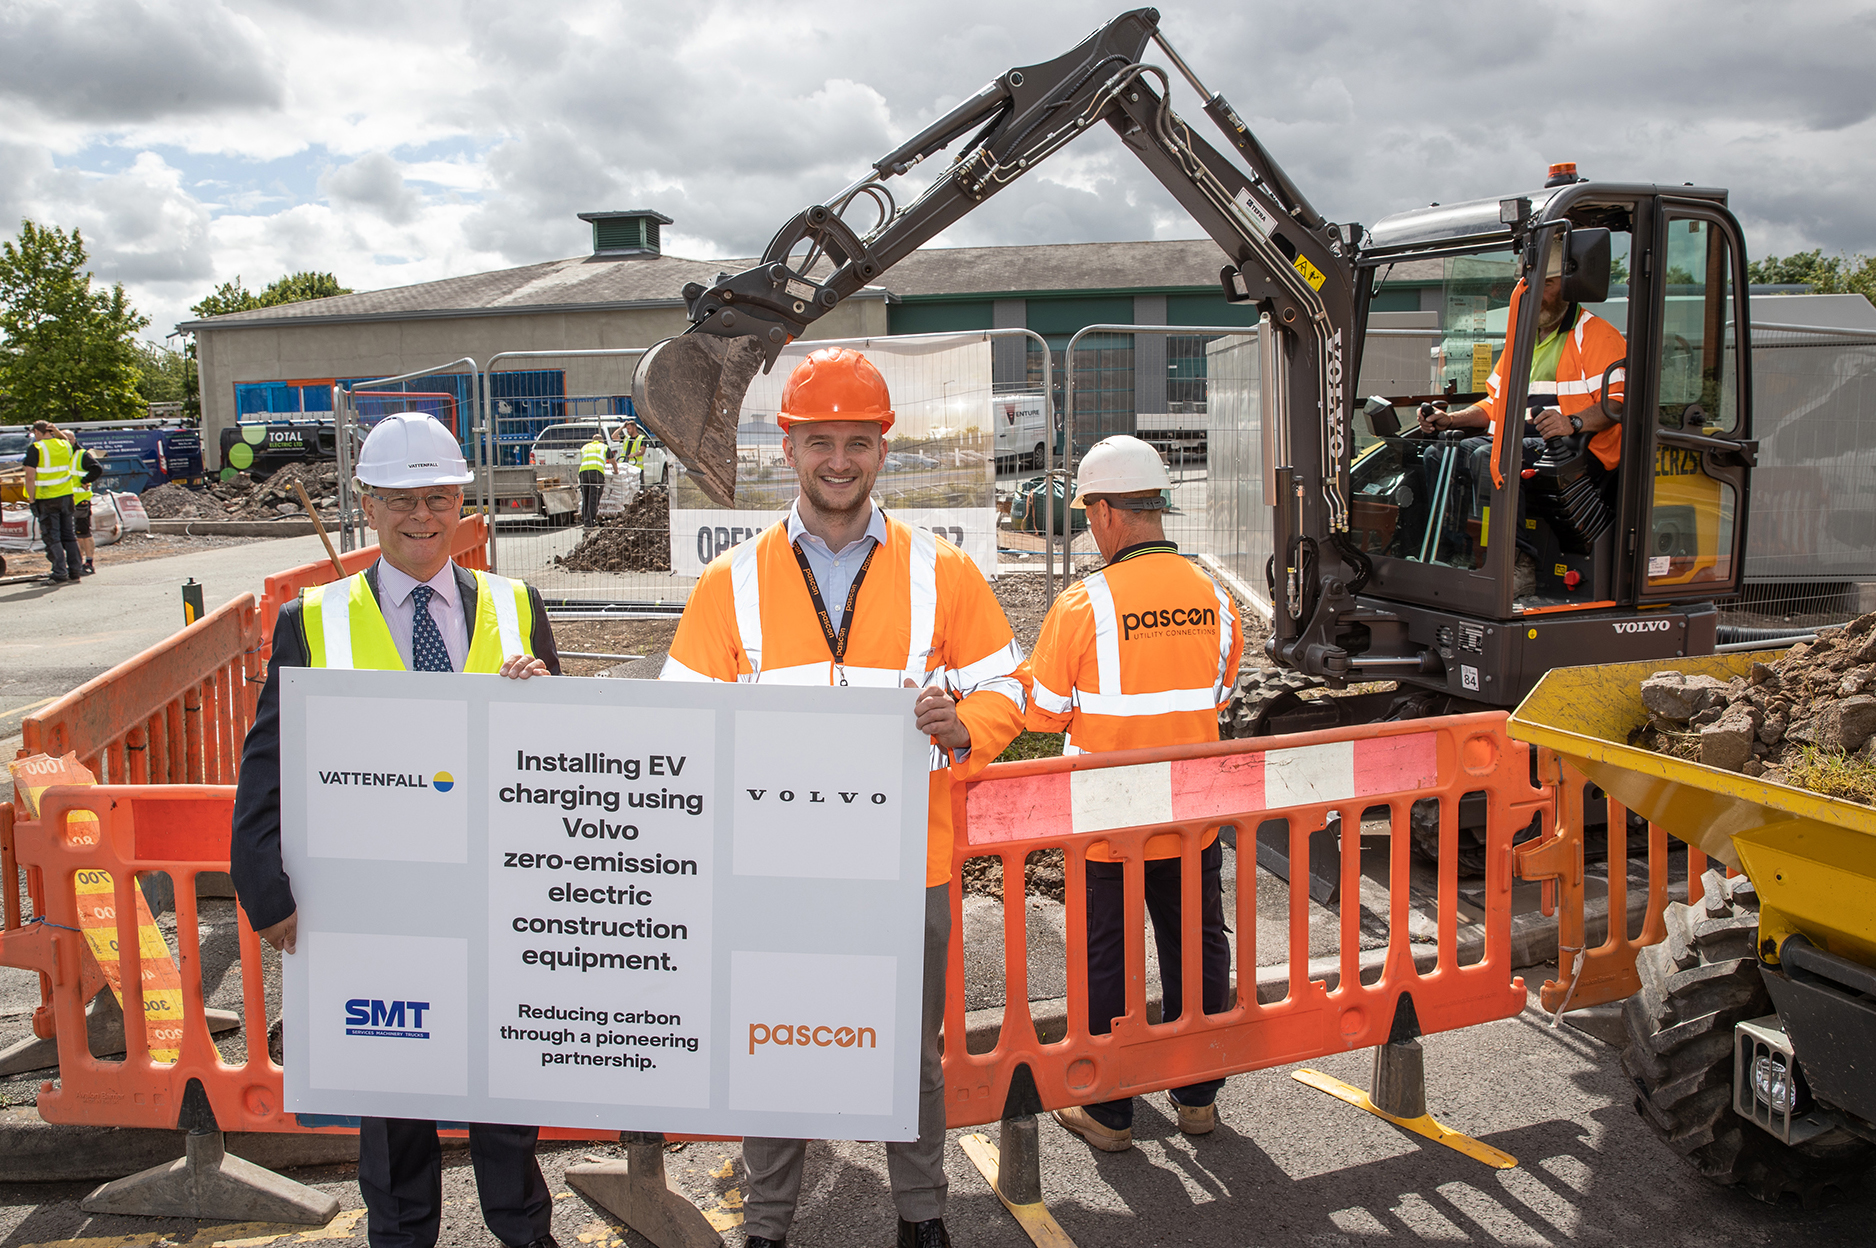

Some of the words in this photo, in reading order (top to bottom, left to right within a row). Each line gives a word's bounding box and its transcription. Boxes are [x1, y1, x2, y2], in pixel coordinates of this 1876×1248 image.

[1327, 328, 1344, 458] VOLVO
[269, 432, 303, 442] TOTAL
[803, 568, 819, 596] pascon
[846, 584, 858, 612] pascon
[818, 610, 835, 639] pascon
[1122, 608, 1215, 641] pascon
[1133, 631, 1163, 640] UTILITY
[1165, 628, 1216, 637] CONNECTIONS
[1612, 620, 1671, 634] VOLVO
[836, 627, 847, 657] pascon
[1464, 674, 1477, 687] 84
[517, 750, 641, 780] Installing
[649, 755, 686, 776] EV
[318, 770, 428, 788] VATTENFALL
[499, 782, 620, 812] charging
[627, 787, 704, 816] using
[746, 789, 887, 805] VOLVO
[562, 817, 639, 840] Volvo
[503, 851, 698, 875] zero-emission
[548, 882, 652, 906] electric
[512, 917, 688, 940] construction
[522, 946, 678, 973] equipment.
[345, 998, 430, 1029] SMT
[518, 1003, 609, 1026] Reducing
[613, 1010, 681, 1026] carbon
[500, 1025, 575, 1046] through
[580, 1032, 591, 1043] a
[596, 1030, 699, 1052] pioneering
[749, 1023, 876, 1055] pascon
[541, 1051, 657, 1072] partnership.
